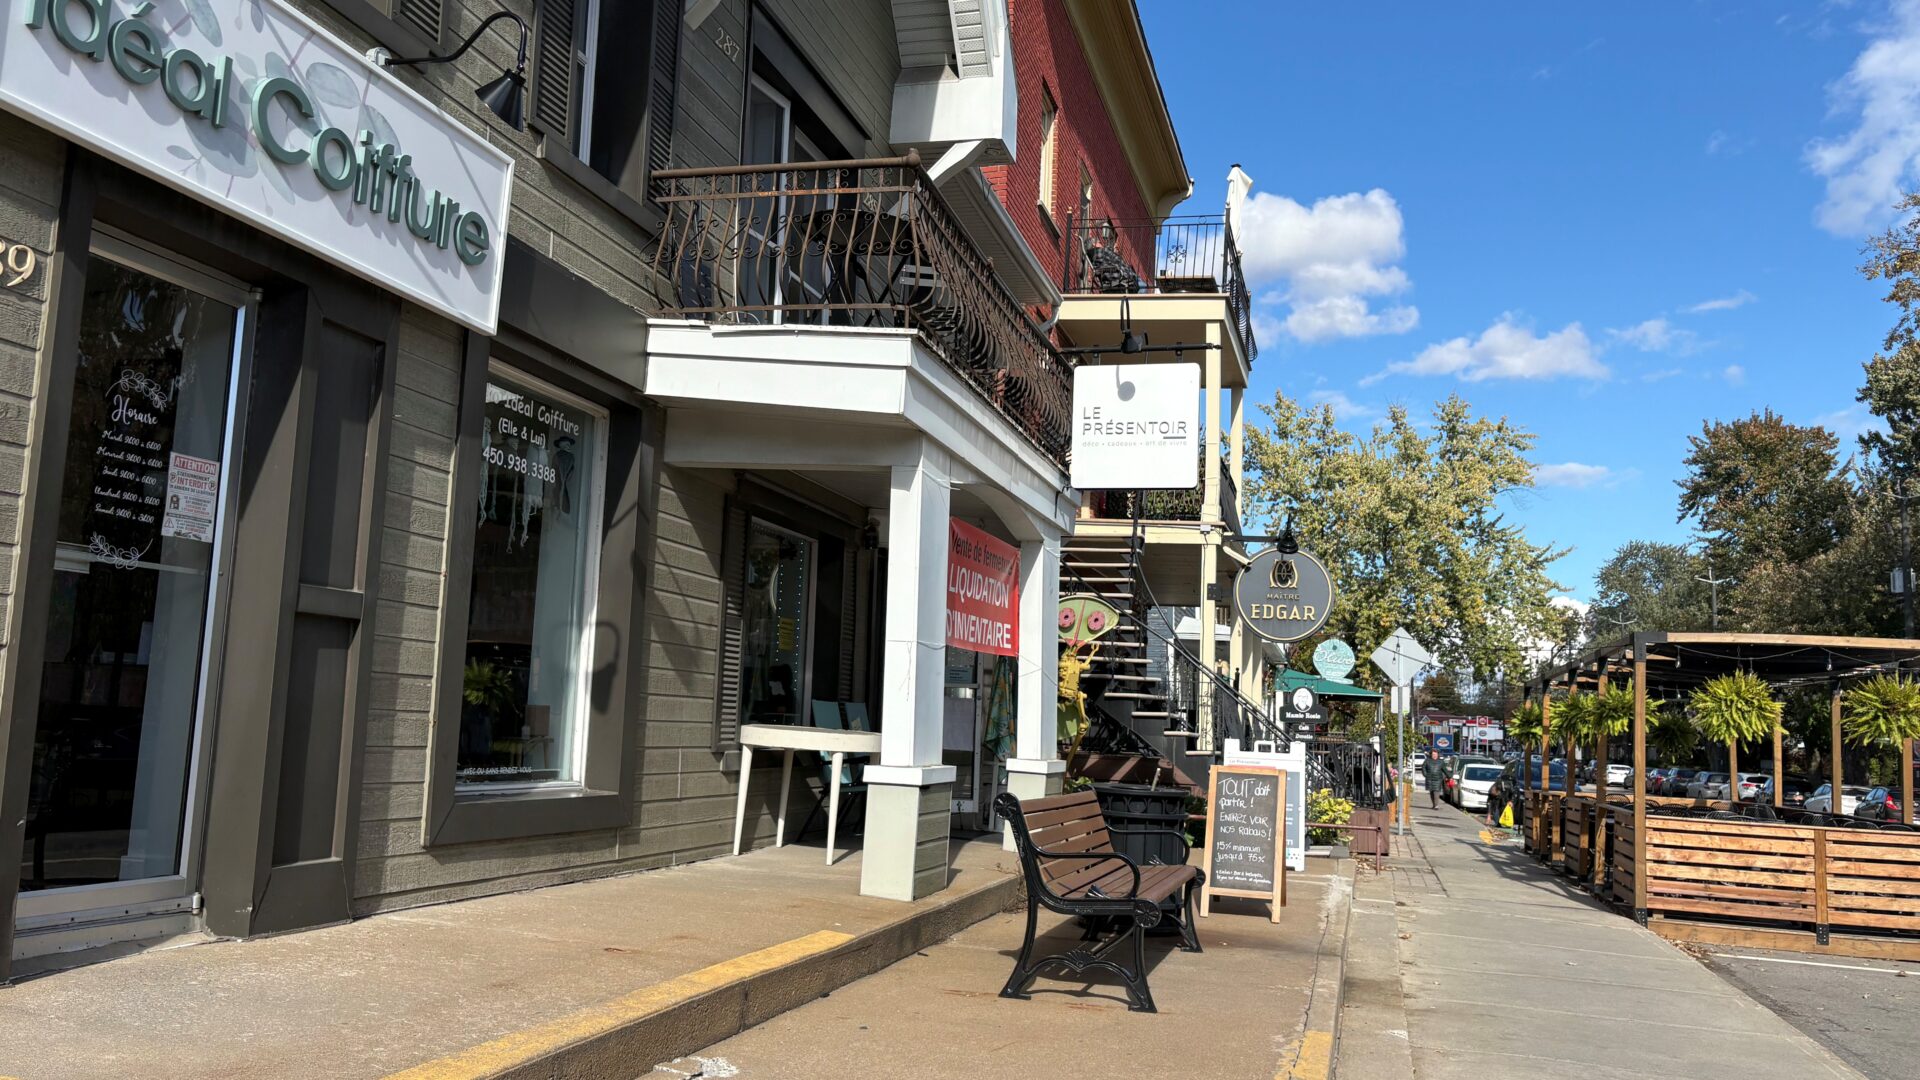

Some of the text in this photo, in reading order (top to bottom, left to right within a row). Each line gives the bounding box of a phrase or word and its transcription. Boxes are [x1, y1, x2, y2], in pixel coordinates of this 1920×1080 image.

[715, 27, 740, 62] 287
[251, 77, 490, 266] Coiffure
[112, 394, 158, 425] Horaire
[537, 406, 580, 436] Coiffure
[1083, 407, 1101, 419] LE
[498, 417, 546, 448] (Elle & Lui)
[1083, 419, 1187, 435] PRÉSENTOIR
[175, 457, 216, 475] ATTENTION
[483, 446, 556, 483] 450.938.3388
[177, 477, 208, 489] INTERDIT
[951, 530, 972, 559] Vente
[973, 540, 982, 562] de
[949, 563, 1009, 608] LIQUIDATION
[1251, 604, 1315, 620] EDGAR
[946, 608, 1012, 648] D'INVENTAIRE
[1286, 711, 1304, 719] Mamie
[1218, 777, 1271, 798] TOUT doit
[1216, 841, 1261, 852] 15% minimum
